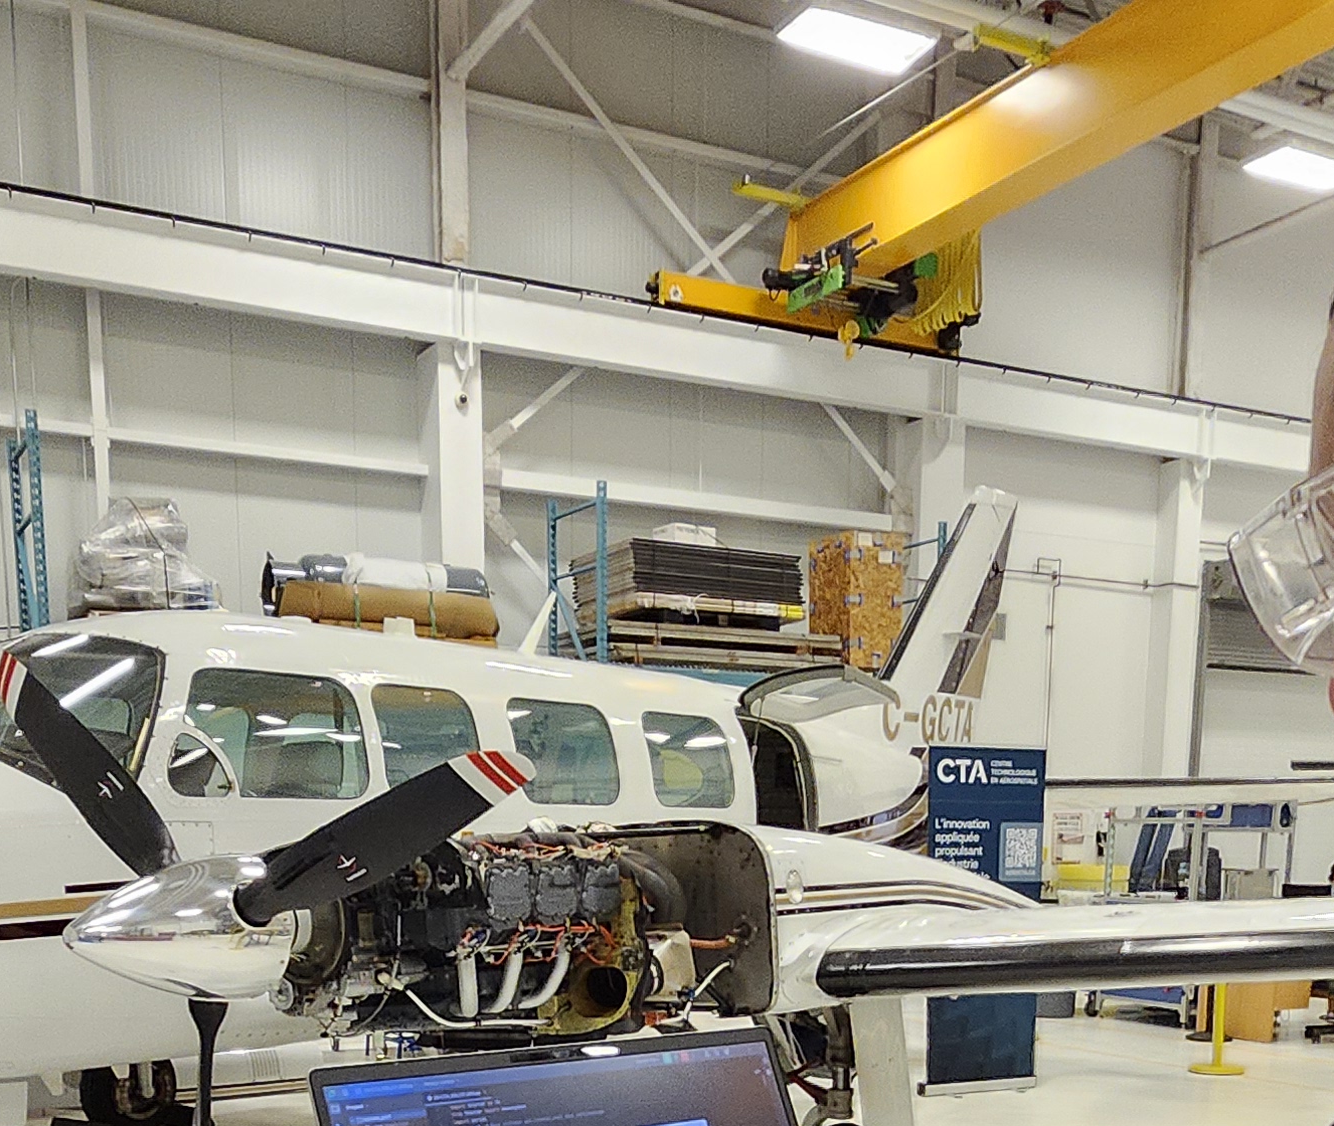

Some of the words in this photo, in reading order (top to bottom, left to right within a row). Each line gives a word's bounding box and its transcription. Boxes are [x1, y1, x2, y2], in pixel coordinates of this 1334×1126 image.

[882, 695, 974, 743] C-GCTA
[936, 758, 988, 784] CTA
[935, 818, 990, 829] L'innovation
[935, 831, 980, 843] appliquée
[935, 846, 983, 858] propulsant
